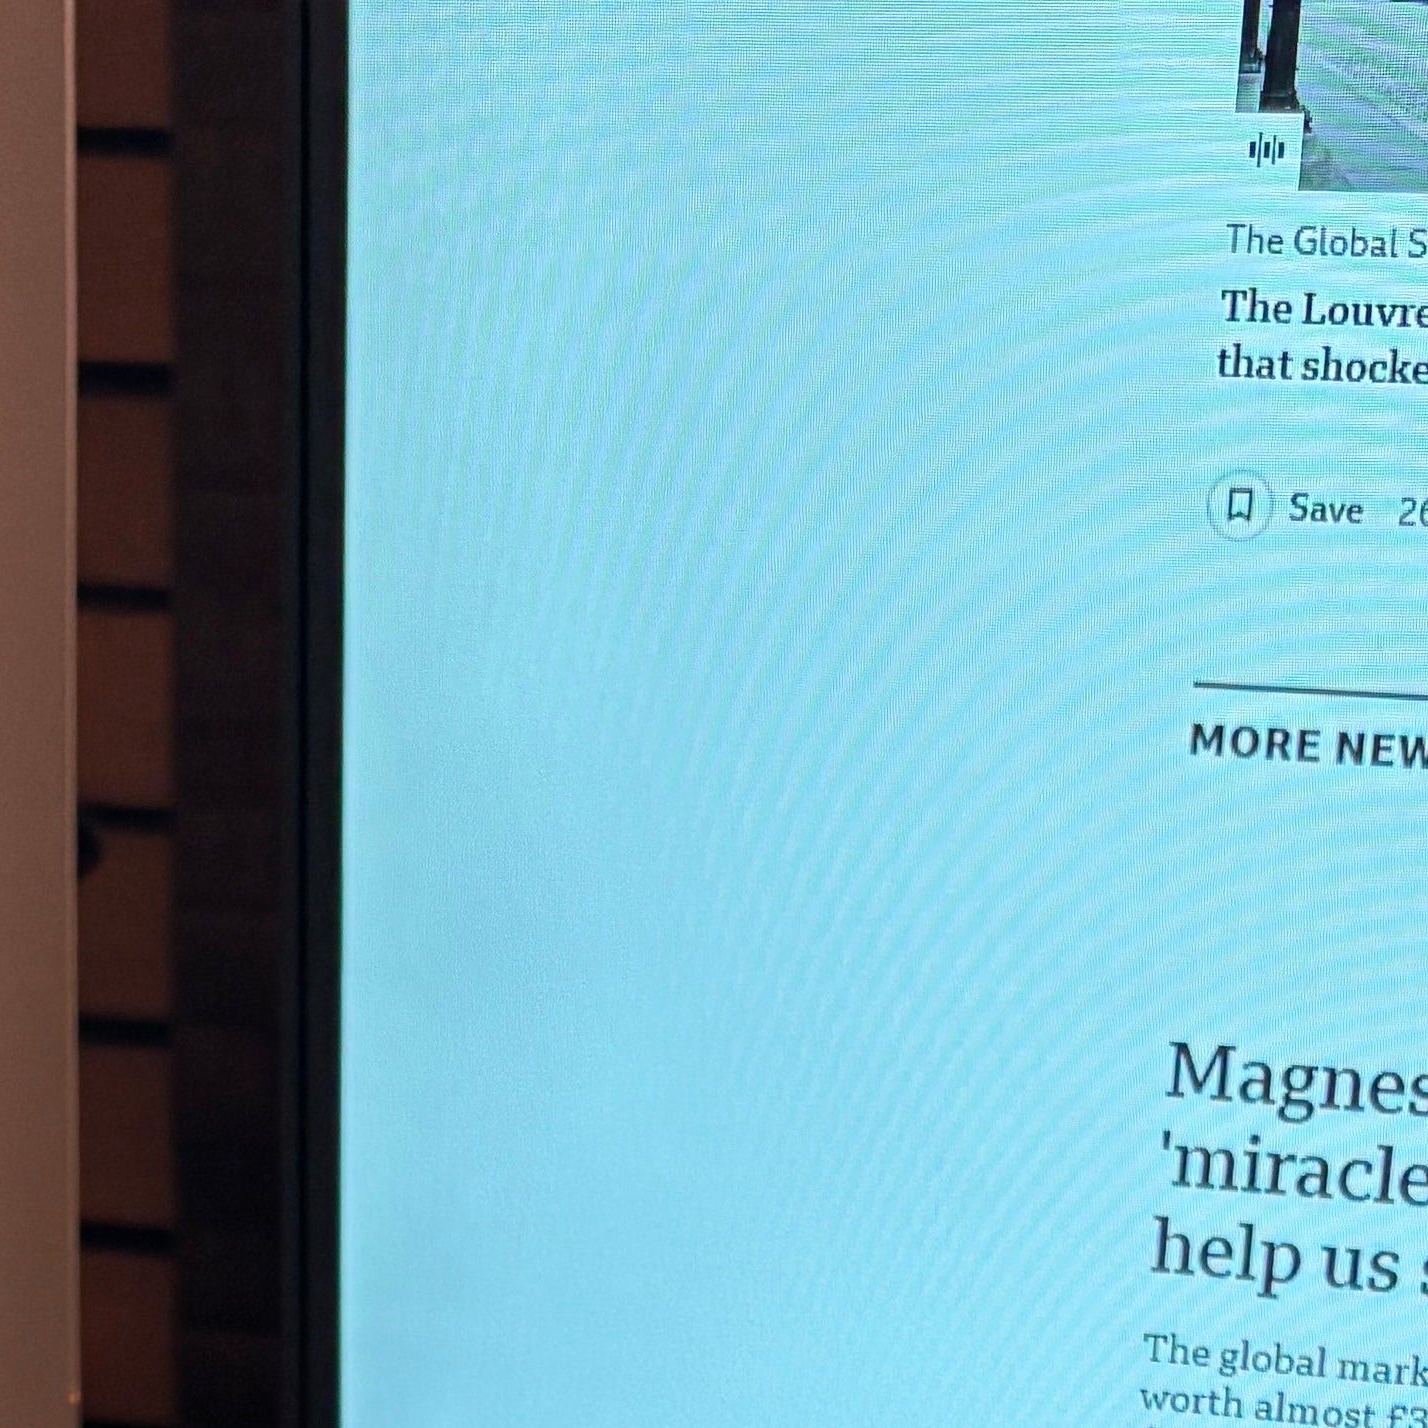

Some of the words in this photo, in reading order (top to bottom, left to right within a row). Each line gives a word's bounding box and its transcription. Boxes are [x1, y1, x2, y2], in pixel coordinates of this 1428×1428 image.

[1227, 224, 1284, 257] The
[1294, 228, 1398, 260] Global
[1222, 288, 1296, 325] The
[1217, 345, 1294, 384] that
[1289, 494, 1364, 524] Save
[1190, 724, 1321, 762] MORE
[1151, 1216, 1302, 1298] help
[1320, 1240, 1398, 1292] us
[1143, 1333, 1211, 1368] The
[1218, 1339, 1327, 1380] global
[1140, 1384, 1244, 1420] worth
